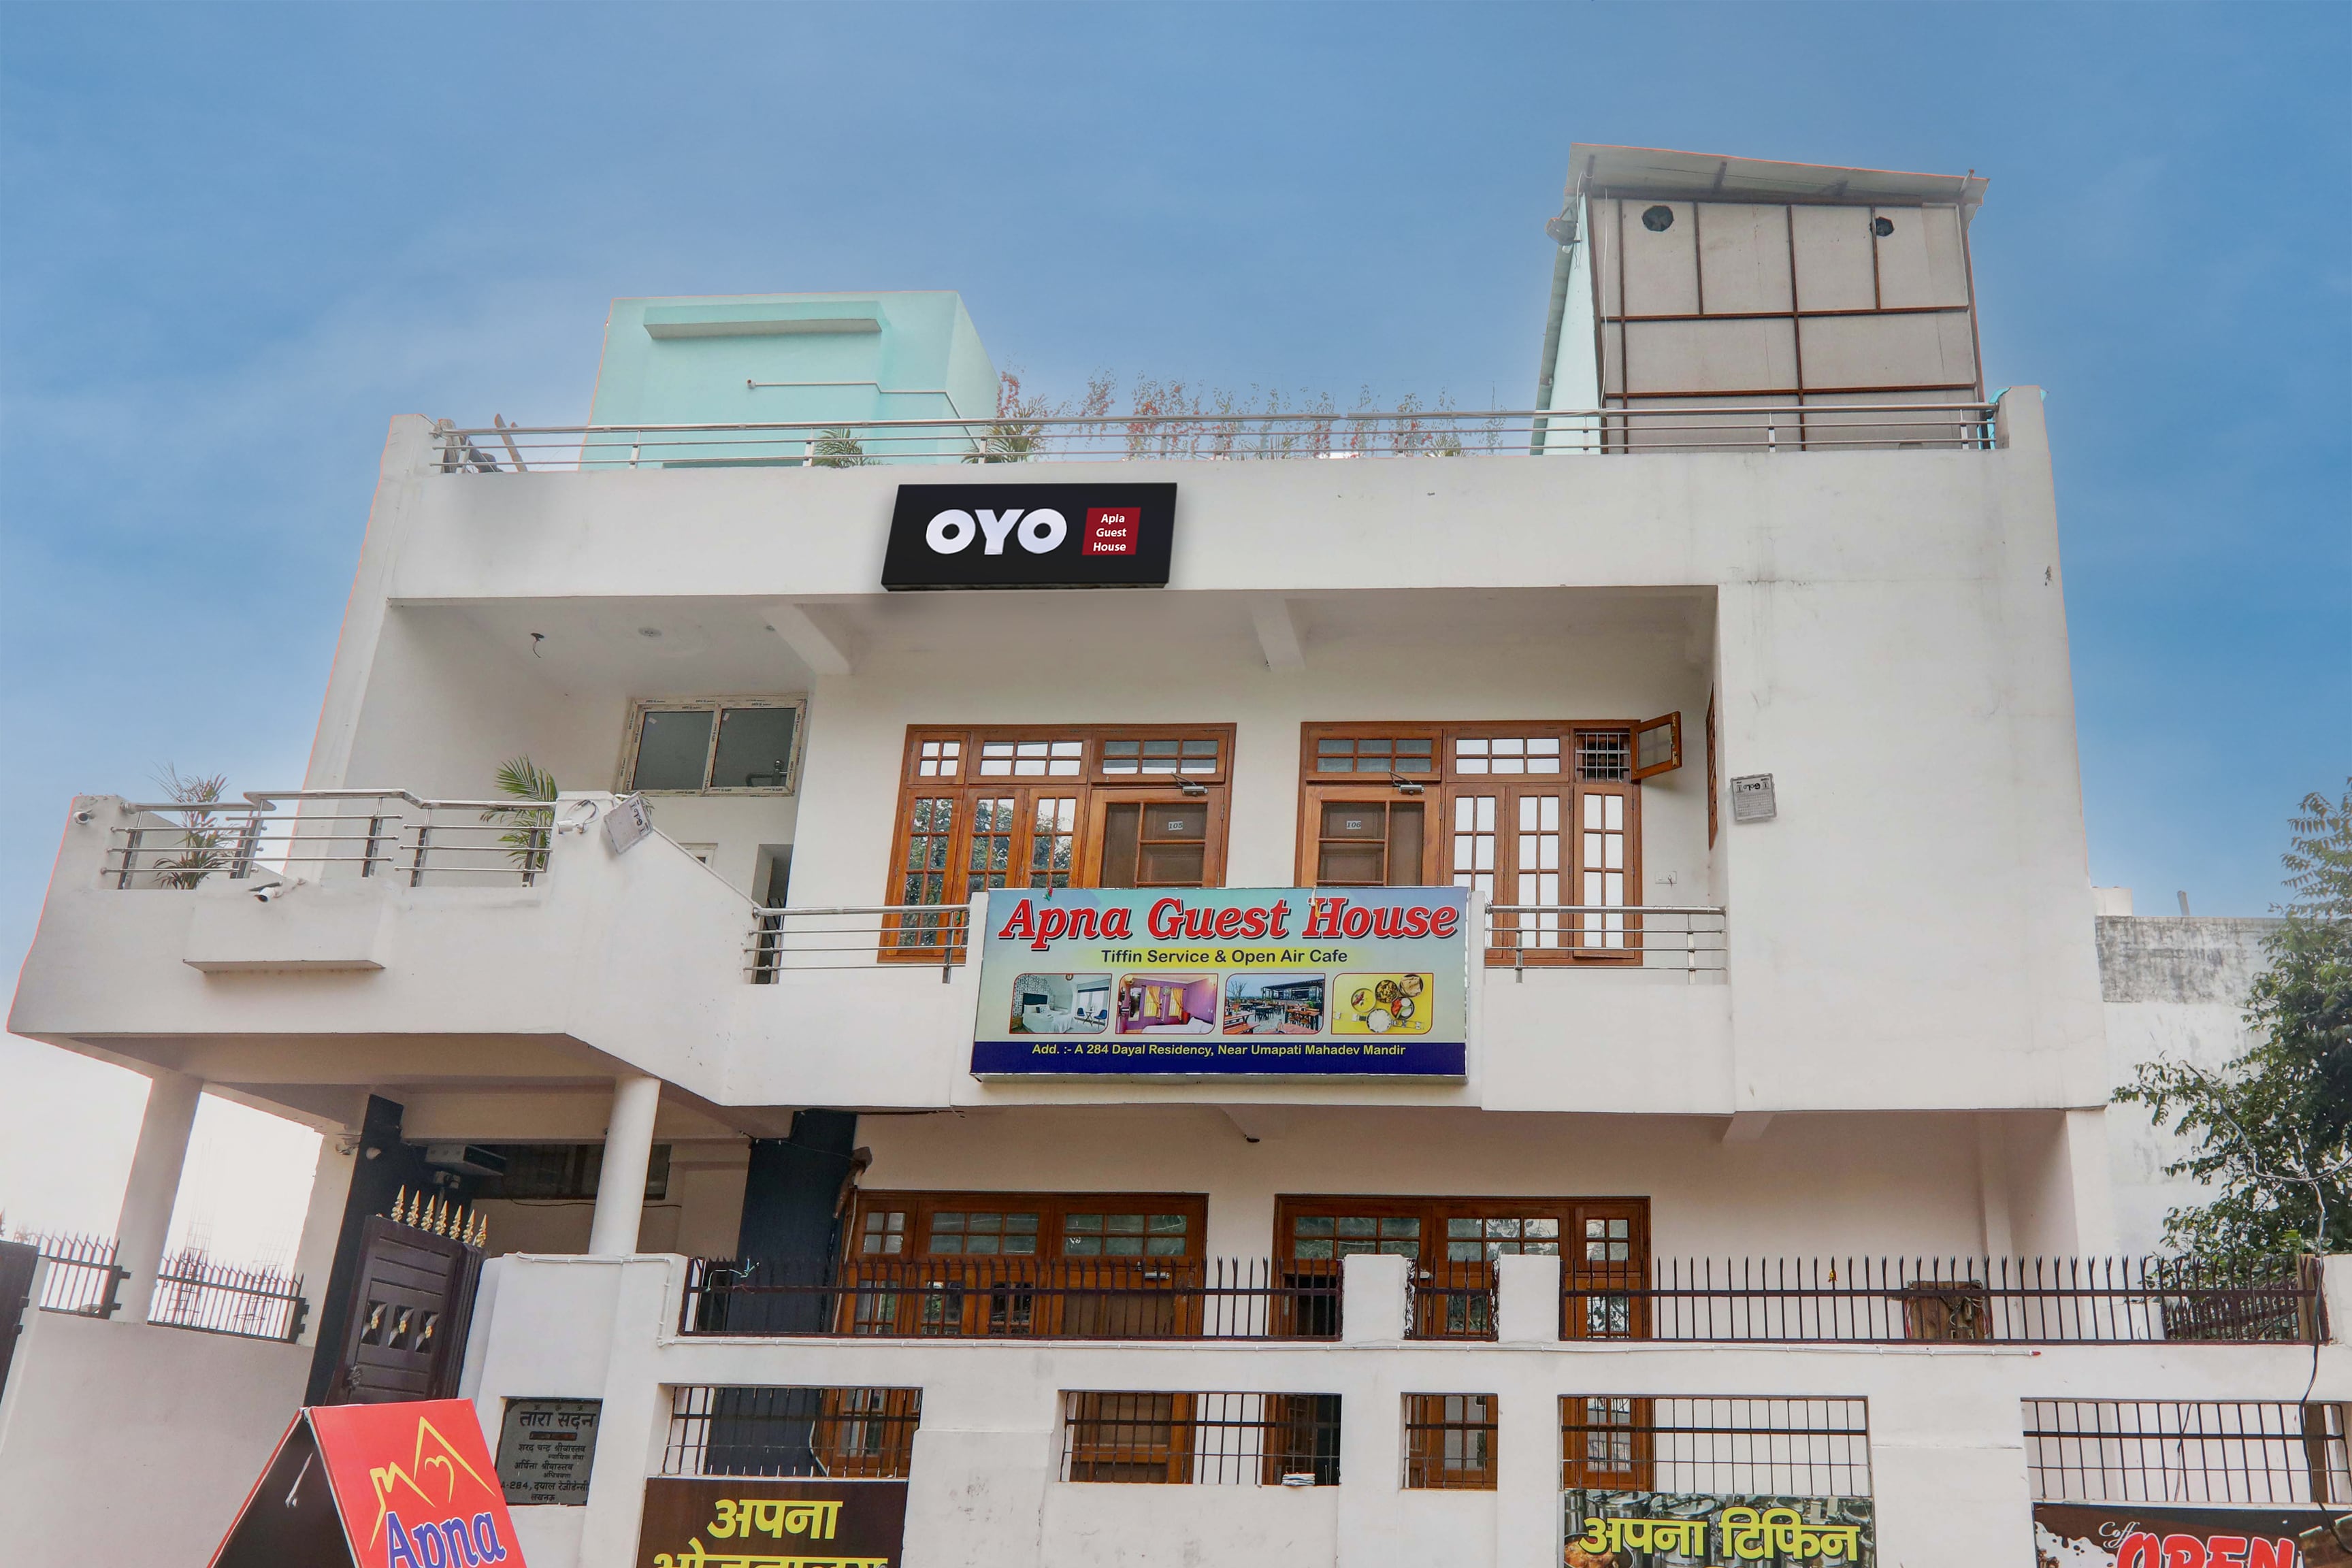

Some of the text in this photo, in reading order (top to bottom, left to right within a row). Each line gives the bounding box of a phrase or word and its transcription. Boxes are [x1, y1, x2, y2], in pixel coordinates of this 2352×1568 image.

[1100, 513, 1125, 525] Apla
[926, 508, 1067, 555] OYO
[1096, 527, 1127, 537] Guest
[1093, 542, 1126, 551] House
[998, 897, 1460, 951] Apna Guest House
[1101, 949, 1348, 966] Tiffin Service & Open Air Cafe
[1032, 1044, 1060, 1054] Add.
[1074, 1045, 1083, 1054] A
[1087, 1045, 1109, 1054] 284
[1112, 1045, 1145, 1056] Dayal
[1149, 1045, 1213, 1056] Residency,
[1218, 1045, 1247, 1055] Near
[1251, 1045, 1301, 1057] Umapati
[1305, 1045, 1360, 1055] Mahadev
[1363, 1045, 1406, 1055] Mandir
[519, 1411, 597, 1430] तारा सदन
[706, 1499, 843, 1539] अपना
[386, 1511, 507, 1568] Apna
[1579, 1506, 1861, 1562] अपना टिफिन
